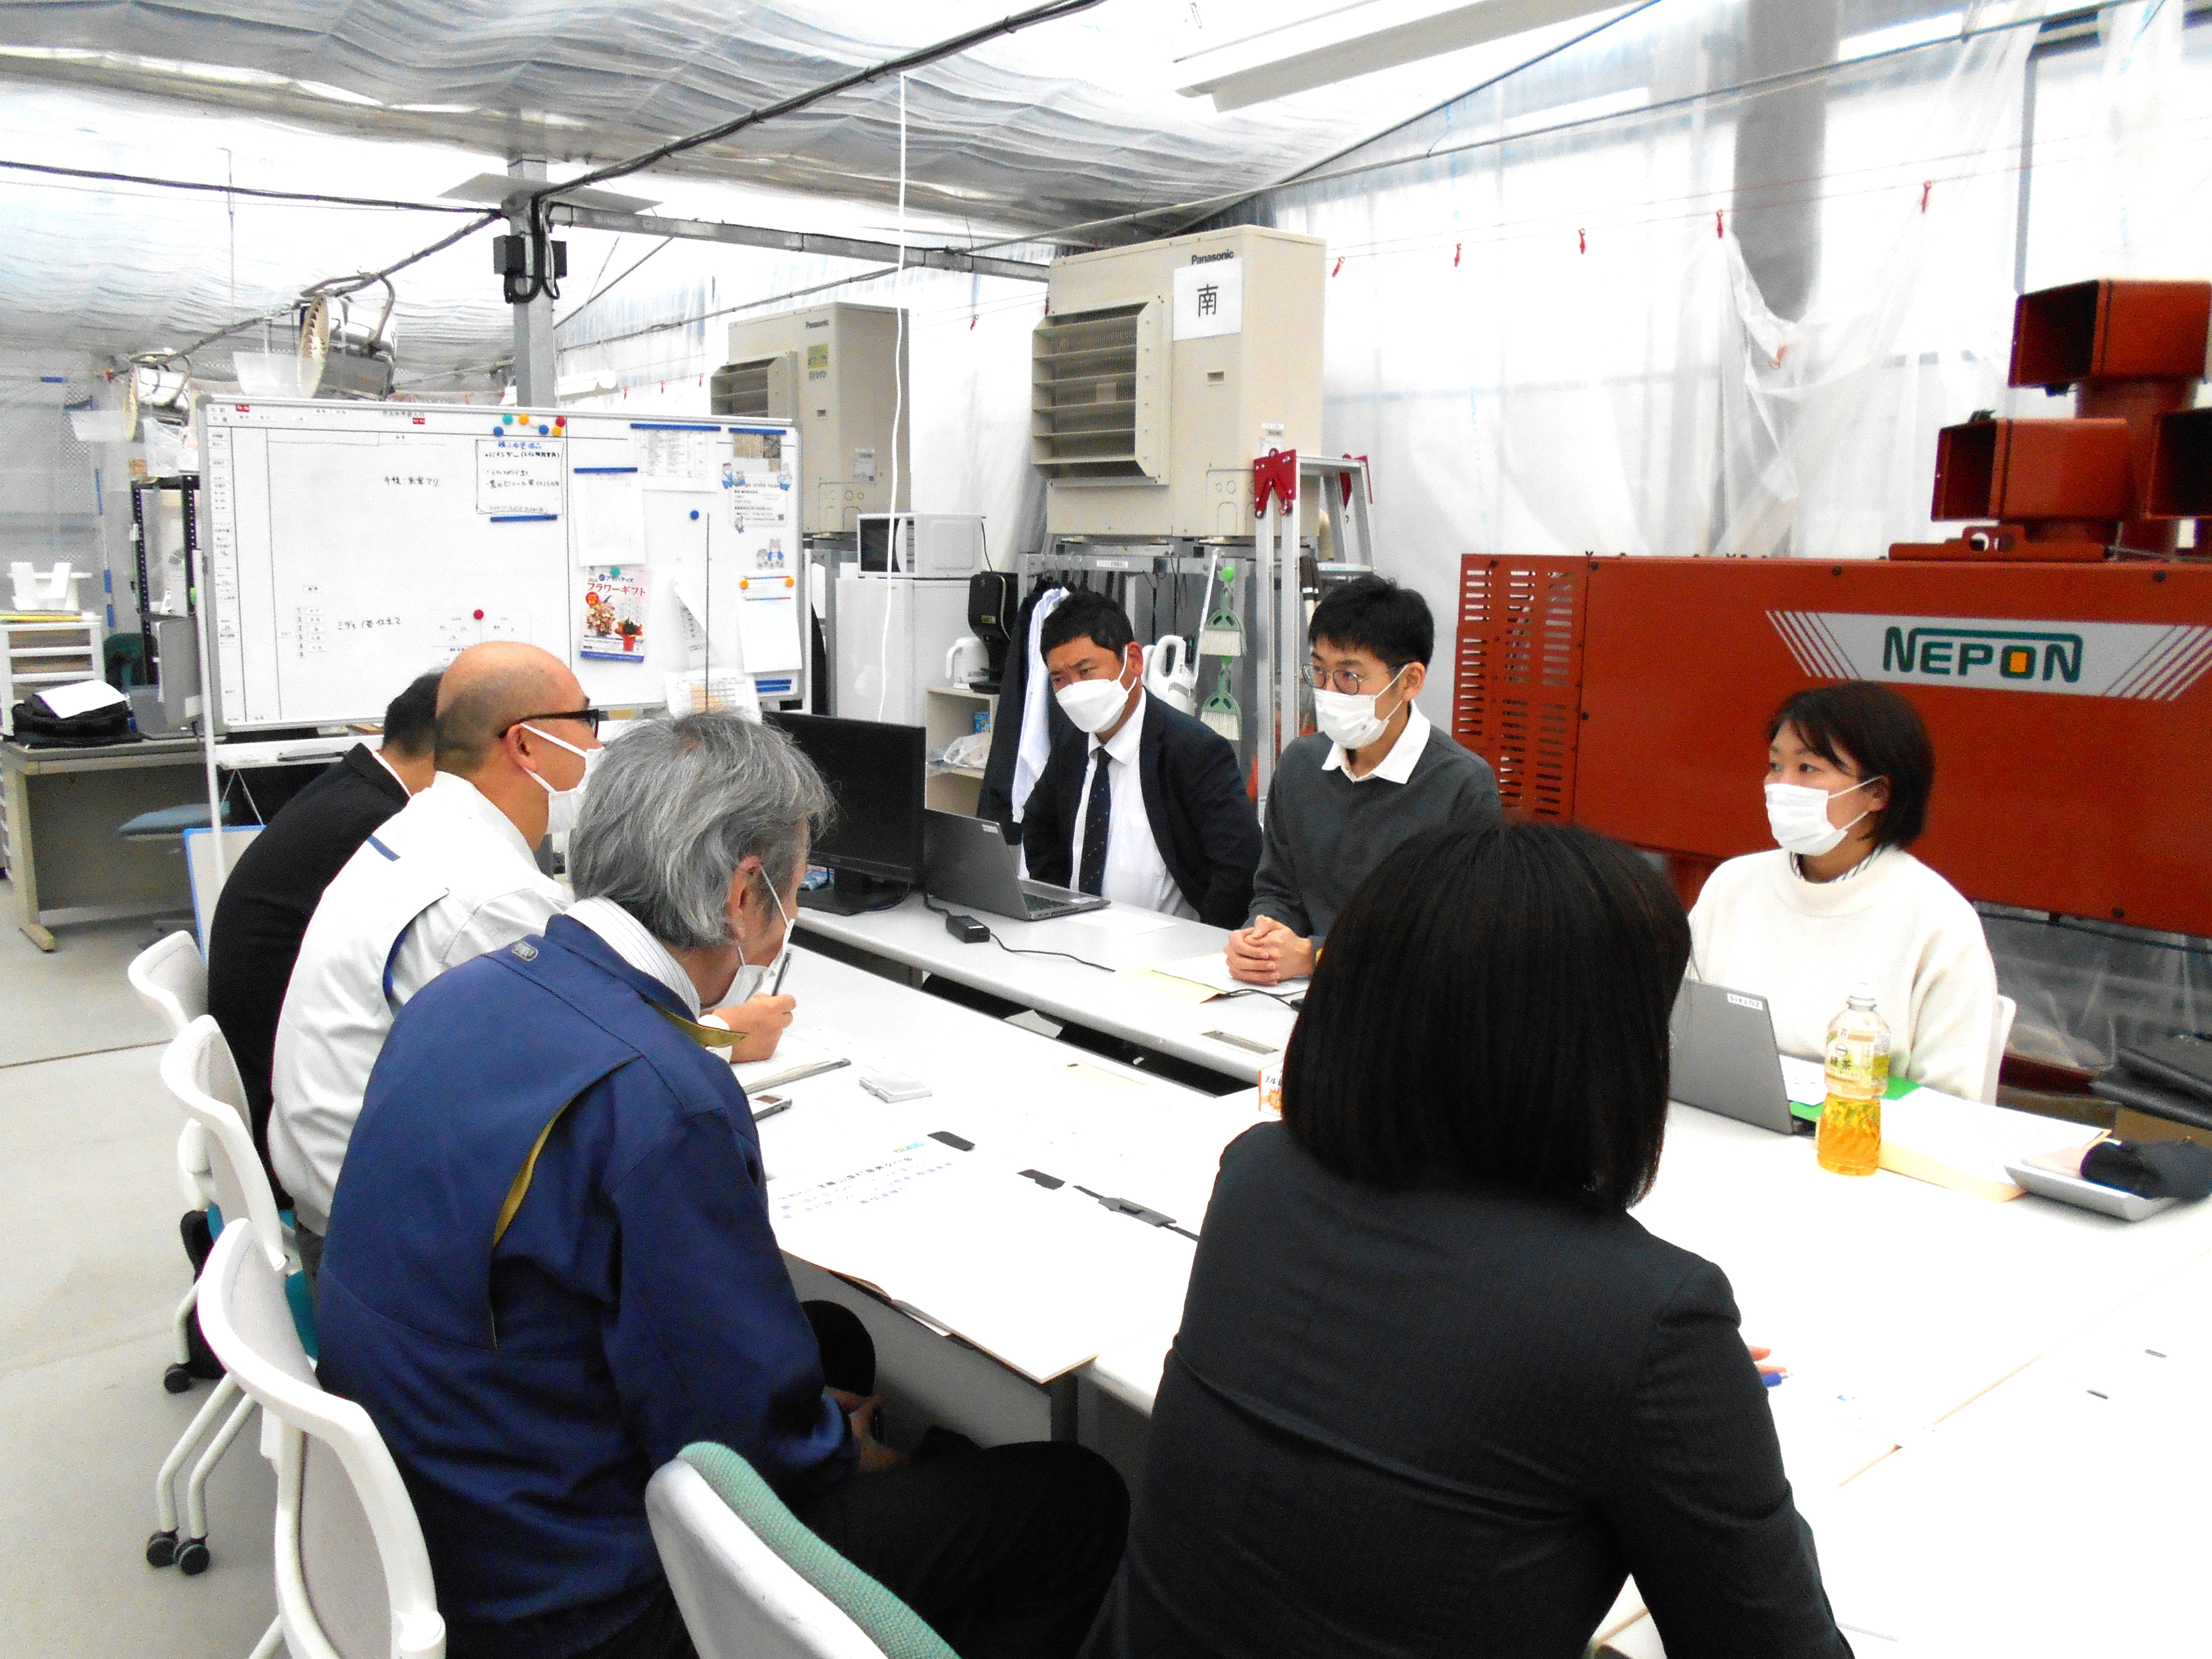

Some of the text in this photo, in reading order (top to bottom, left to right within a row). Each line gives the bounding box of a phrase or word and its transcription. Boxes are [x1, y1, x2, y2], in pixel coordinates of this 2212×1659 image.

[1191, 249, 1234, 265] Panasonic
[1197, 284, 1218, 317] 南
[587, 583, 646, 596] フラワーギフト
[1883, 626, 2083, 683] NEPON
[1830, 1056, 1852, 1070] 緑茶
